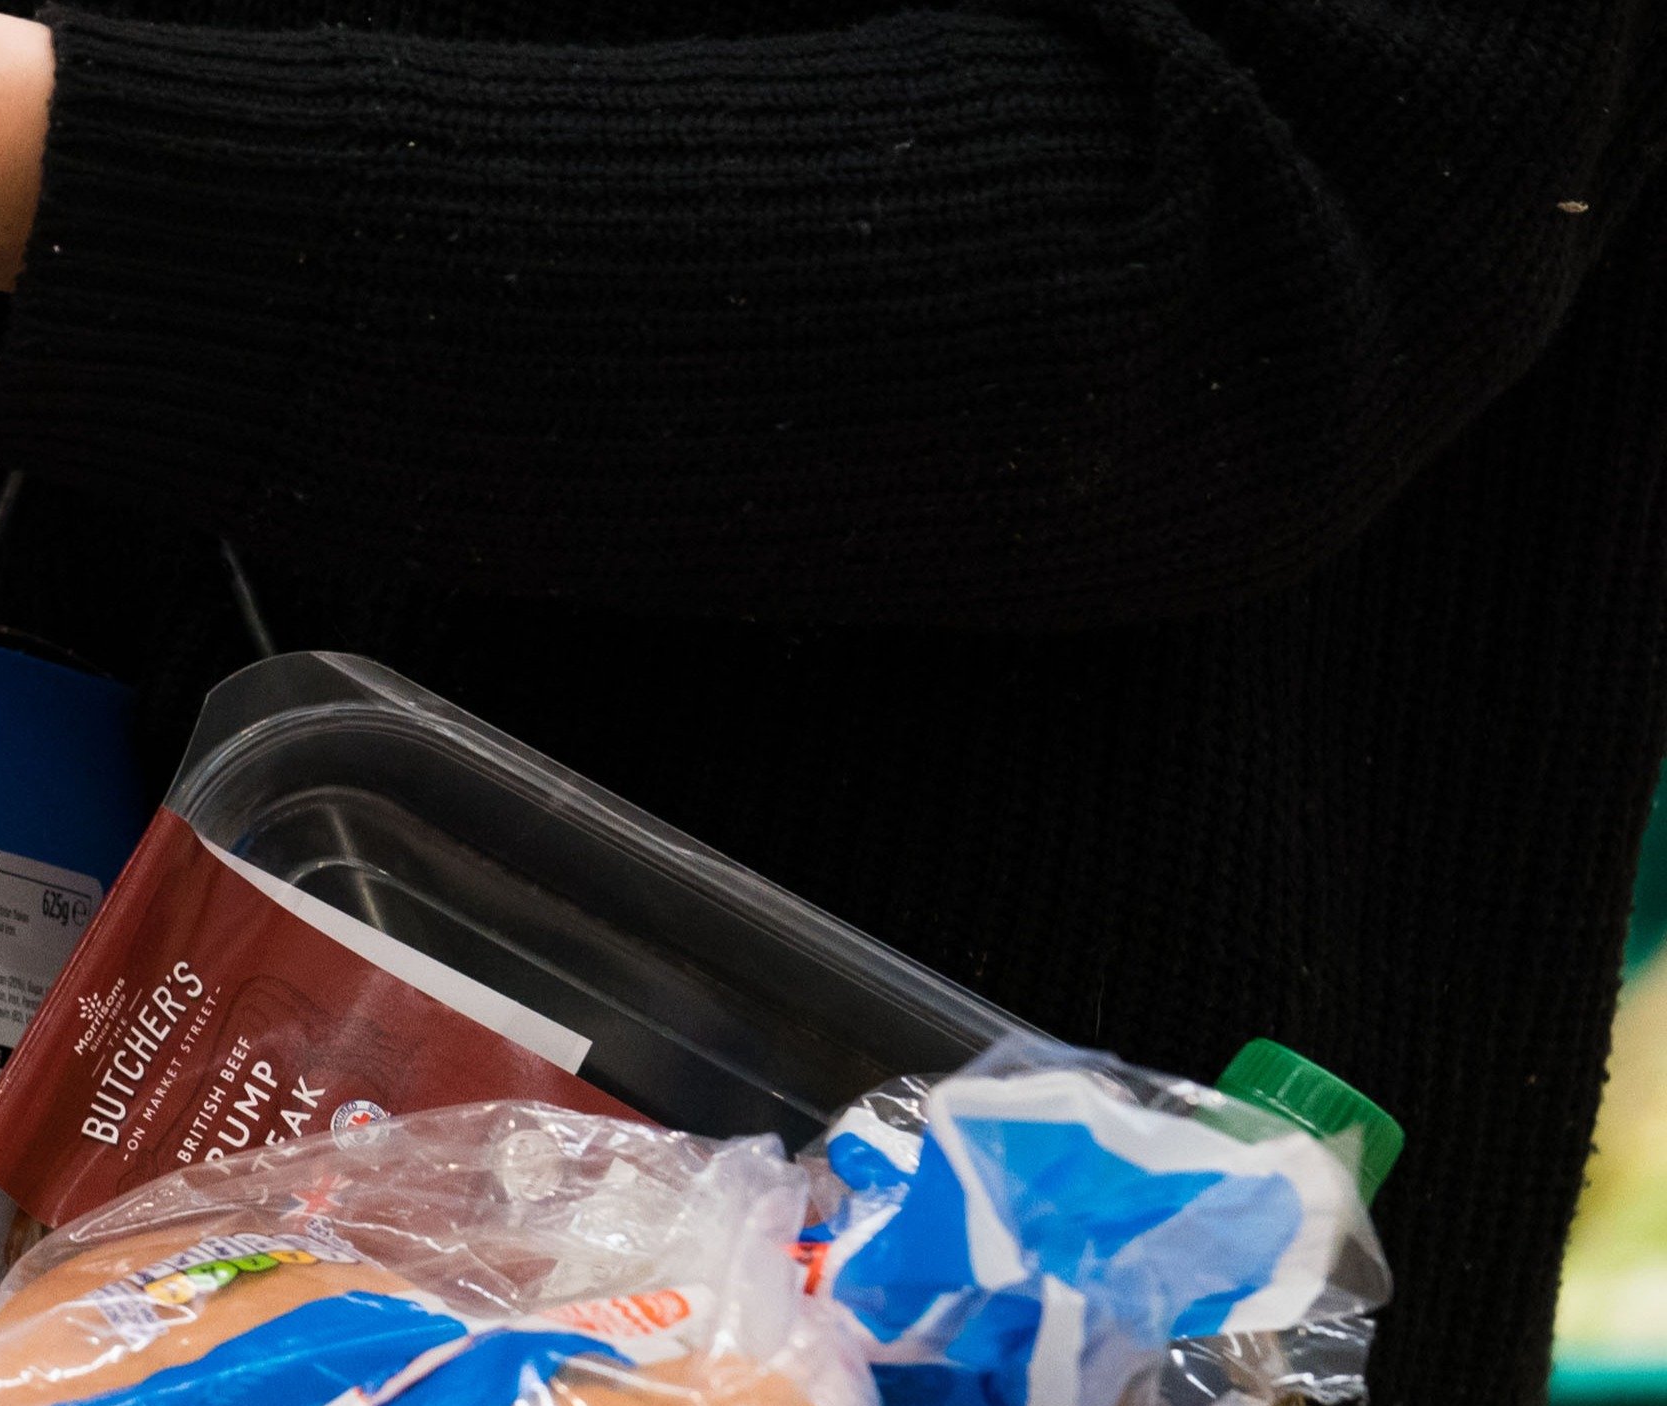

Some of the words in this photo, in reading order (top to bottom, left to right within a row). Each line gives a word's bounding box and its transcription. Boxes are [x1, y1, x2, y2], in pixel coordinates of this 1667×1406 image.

[42, 889, 70, 926] 625g
[74, 977, 125, 1056] Morrisons
[81, 961, 204, 1145] BUTCHER'S
[89, 1022, 111, 1053] Since
[107, 1017, 128, 1049] THE
[126, 1126, 146, 1151] ON
[142, 1057, 183, 1122] MARKET
[180, 996, 217, 1054] STREET
[176, 1085, 227, 1164] BRITISH
[219, 1035, 252, 1083] BEEF
[204, 1060, 279, 1176] RUMP
